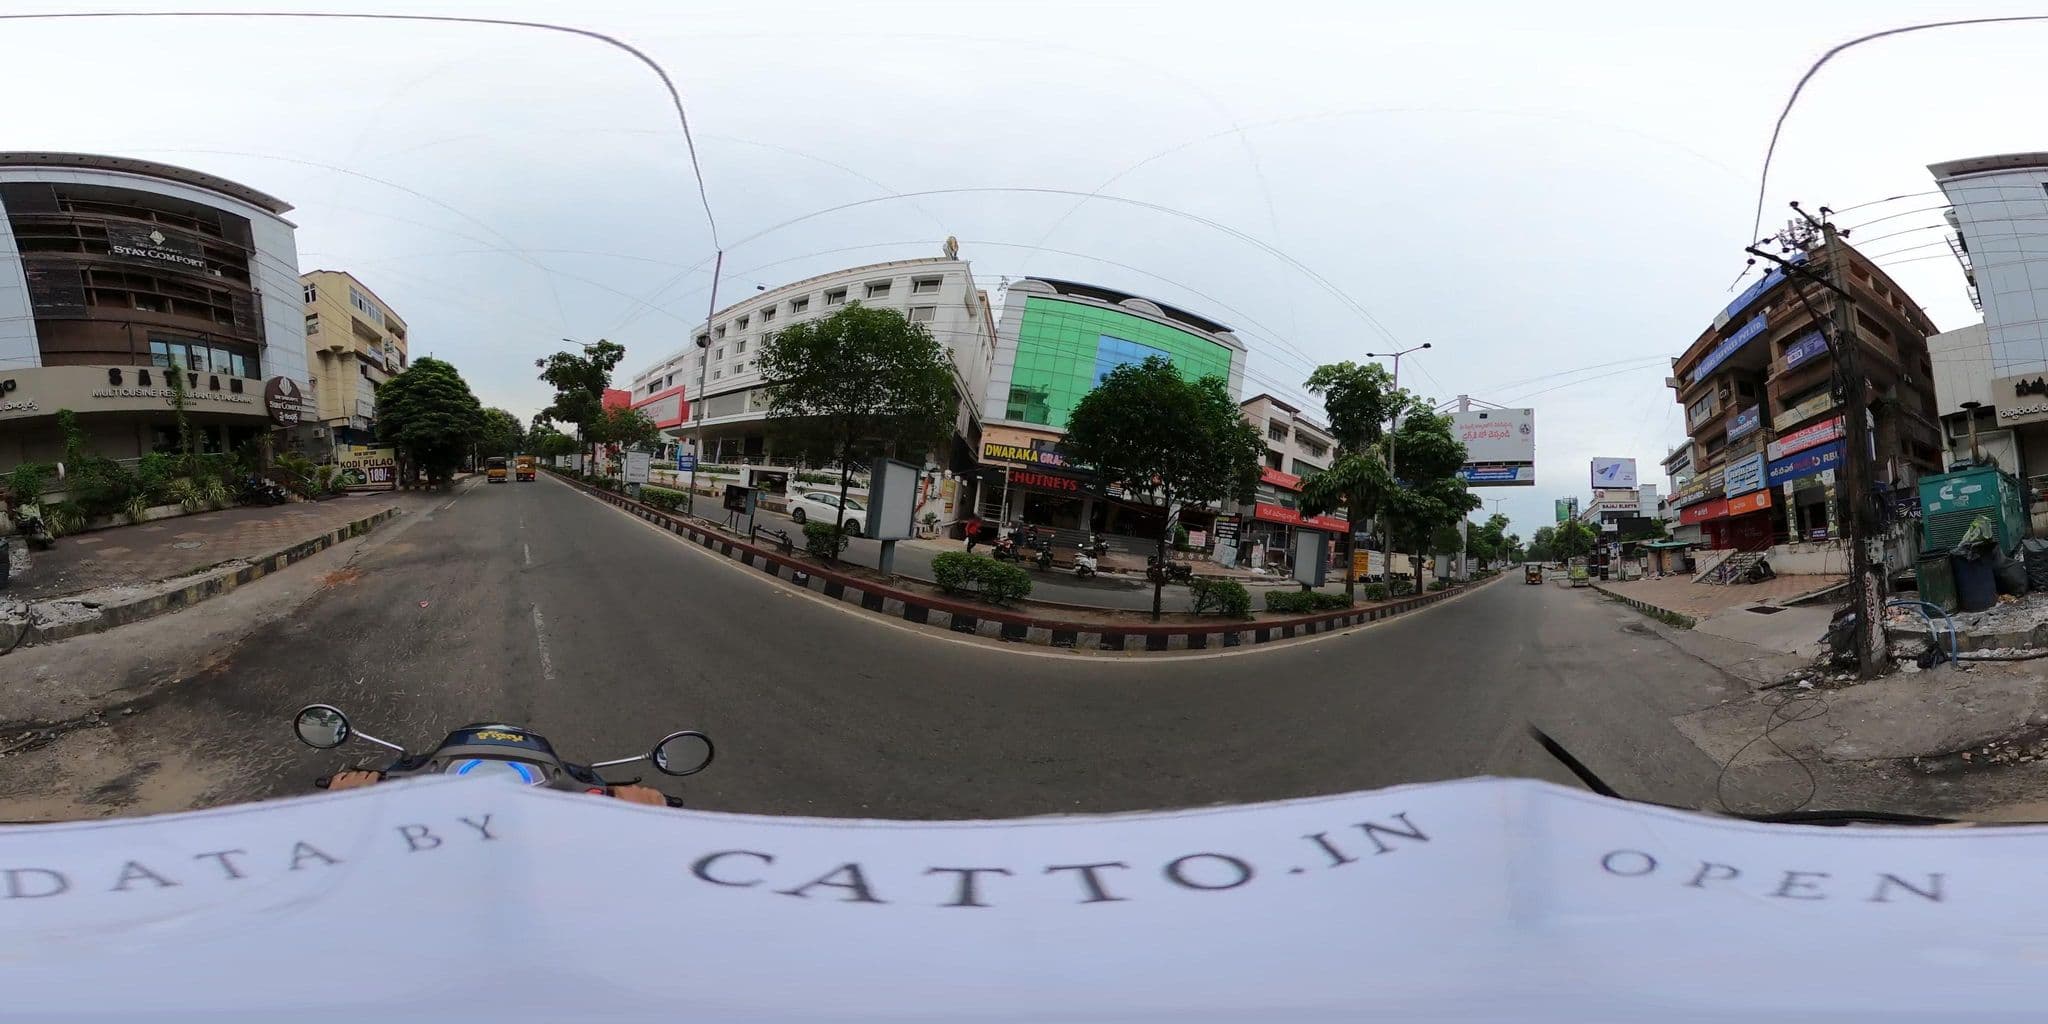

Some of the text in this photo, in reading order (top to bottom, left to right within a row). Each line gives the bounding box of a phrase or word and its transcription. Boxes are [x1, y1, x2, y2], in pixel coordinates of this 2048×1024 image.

[113, 245, 146, 256] STAY
[147, 250, 204, 267] COMFORT
[92, 387, 156, 398] MULTICUSINE
[159, 389, 211, 400] RESAURANT
[340, 458, 394, 469] KODI PULAO
[985, 444, 1038, 462] DWARAKA
[1008, 469, 1078, 492] CHUTNEYS
[0, 813, 497, 900] DATA BY
[688, 811, 1431, 909] CATTO.IN
[1599, 849, 1946, 904] OPEN
